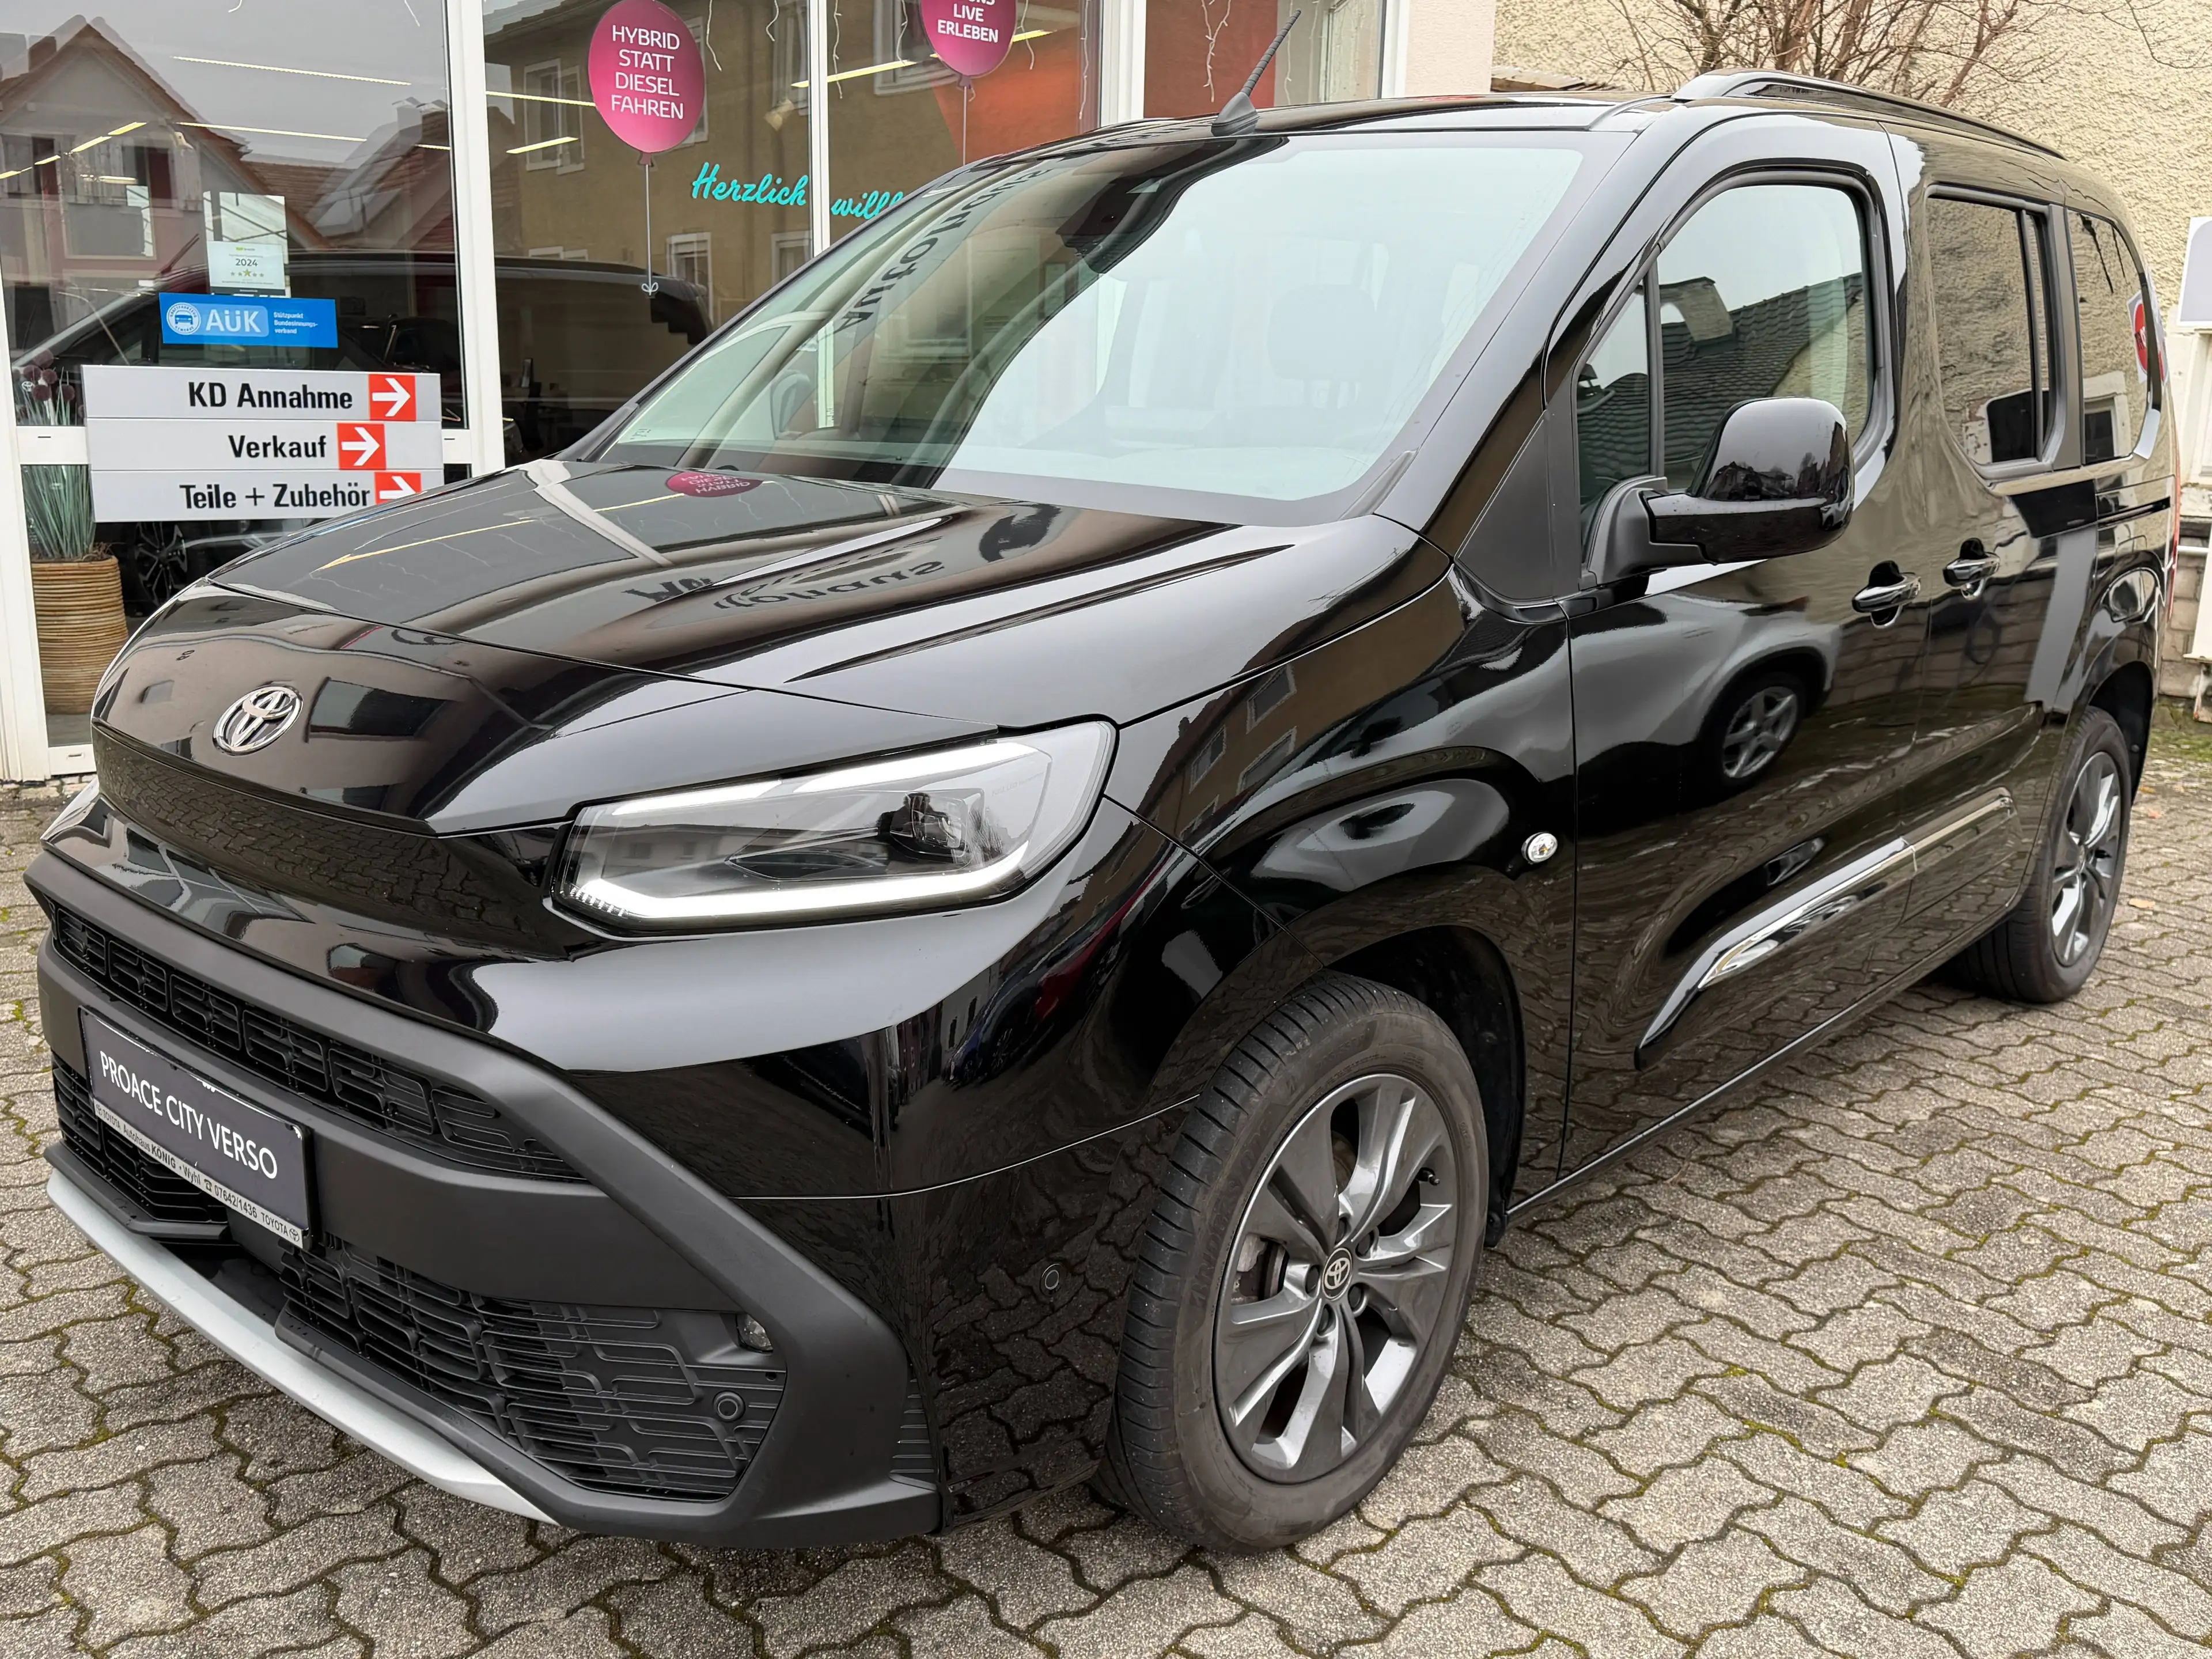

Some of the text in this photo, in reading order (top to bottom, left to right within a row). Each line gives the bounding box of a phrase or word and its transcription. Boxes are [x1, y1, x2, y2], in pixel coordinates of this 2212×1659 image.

[953, 3, 984, 22] LIVE
[612, 25, 680, 50] HYBRID
[938, 20, 998, 43] ERLEBEN
[619, 49, 675, 72] STATT
[615, 71, 680, 96] DIESEL
[611, 94, 684, 120] FAHREN
[692, 161, 809, 206] Herzlich
[235, 258, 258, 267] 2024
[188, 381, 353, 409] KD Annahme
[228, 435, 327, 458] Verkauf
[179, 482, 370, 509] Teile + Zubehör
[100, 1051, 278, 1179] PROACE CITY VERSO
[103, 1109, 289, 1238] TOYOTA Autohaus KÖNIG Wyhl 07642/1436 TOYOTA
